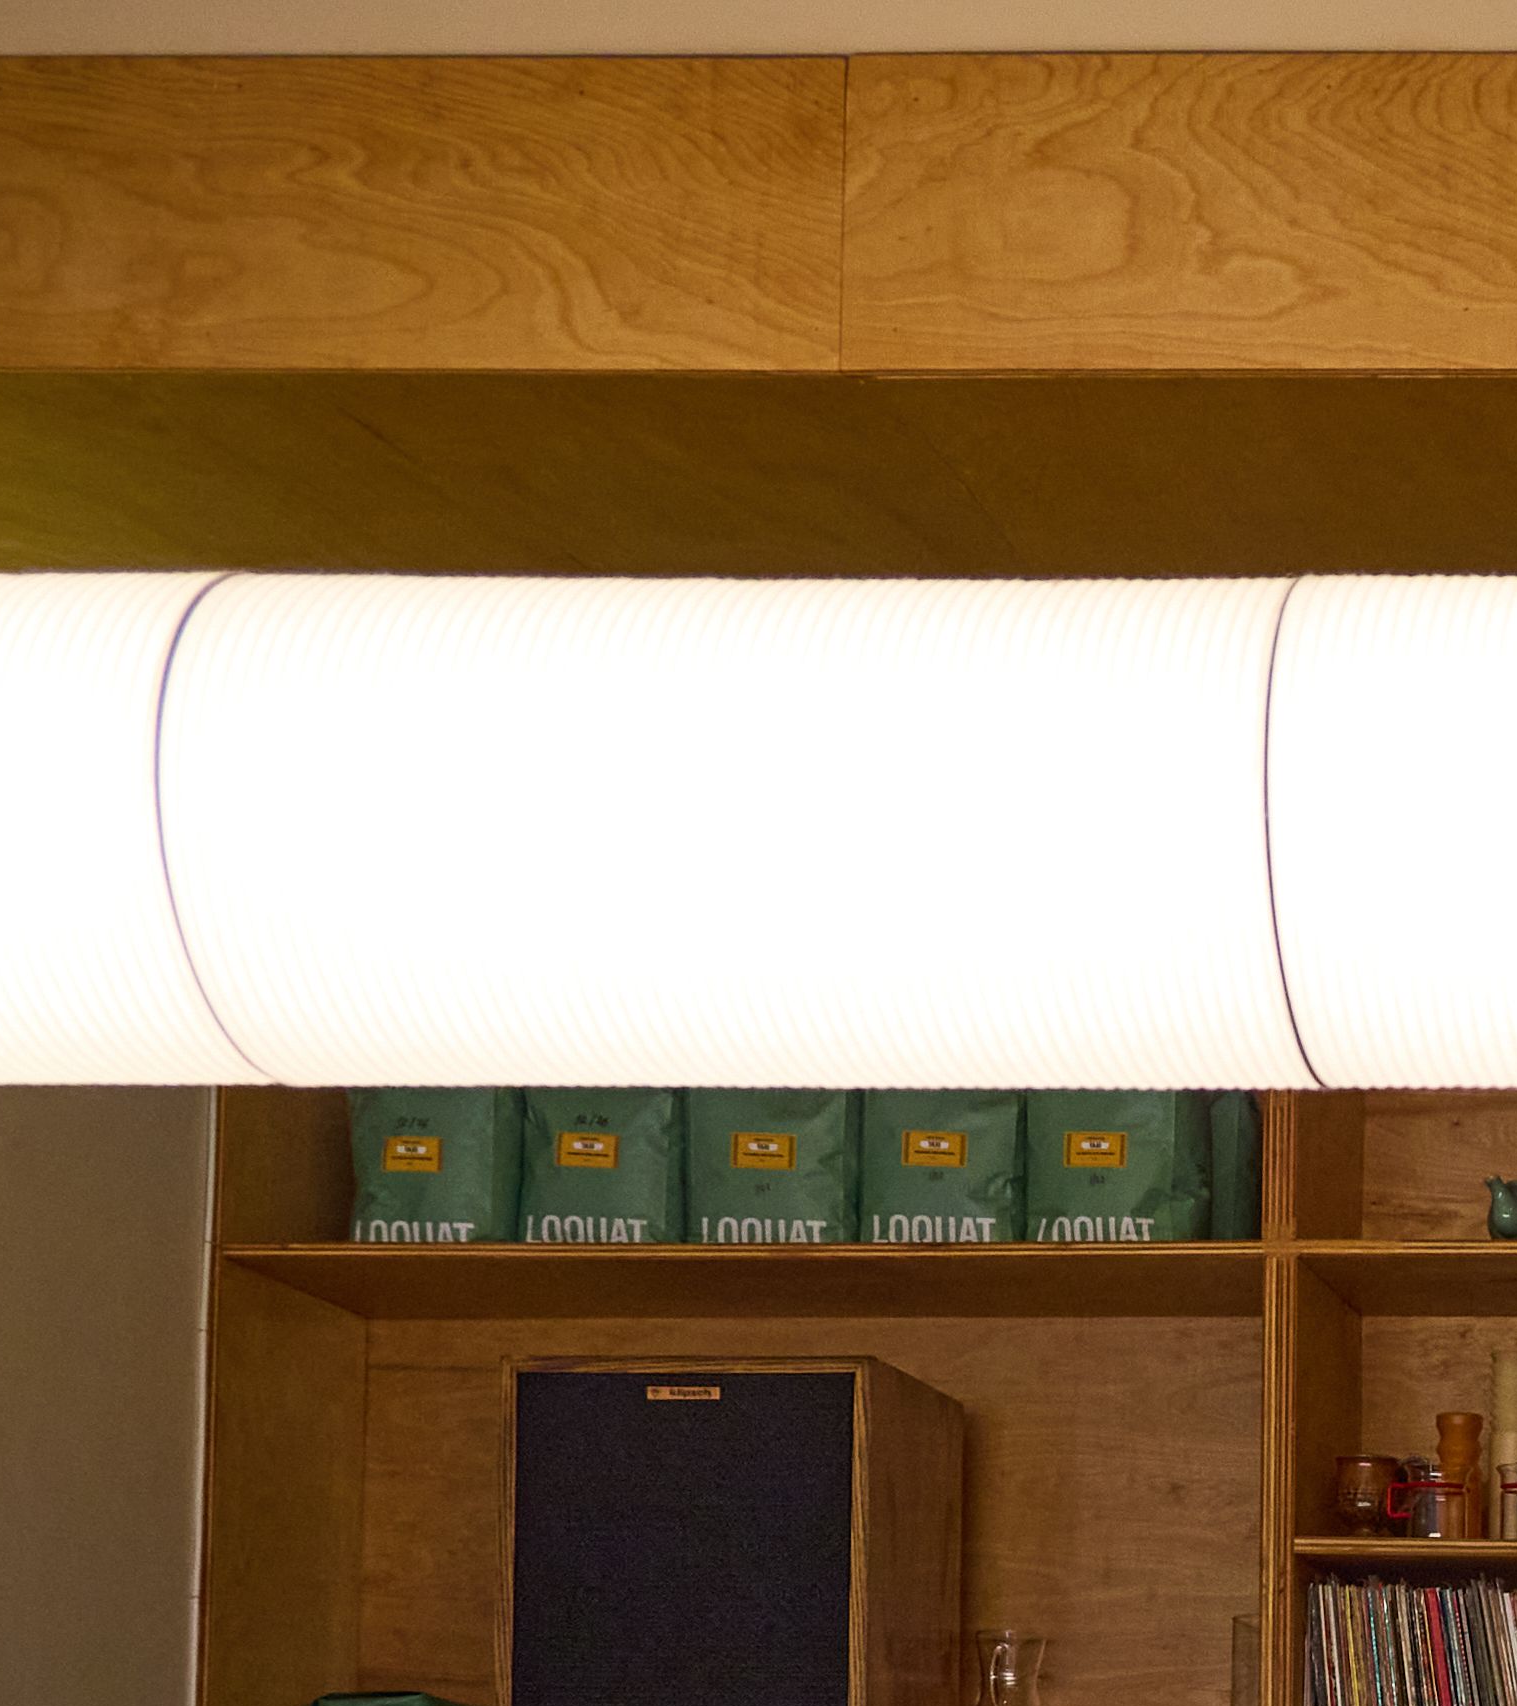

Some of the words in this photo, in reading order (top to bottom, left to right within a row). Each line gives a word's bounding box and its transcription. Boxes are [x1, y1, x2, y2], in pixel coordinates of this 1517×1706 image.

[526, 1214, 648, 1243] LOQUAT
[701, 1216, 827, 1243] LOQUAT
[872, 1214, 996, 1243] LOQUAT
[1037, 1216, 1155, 1242] LOQUAT
